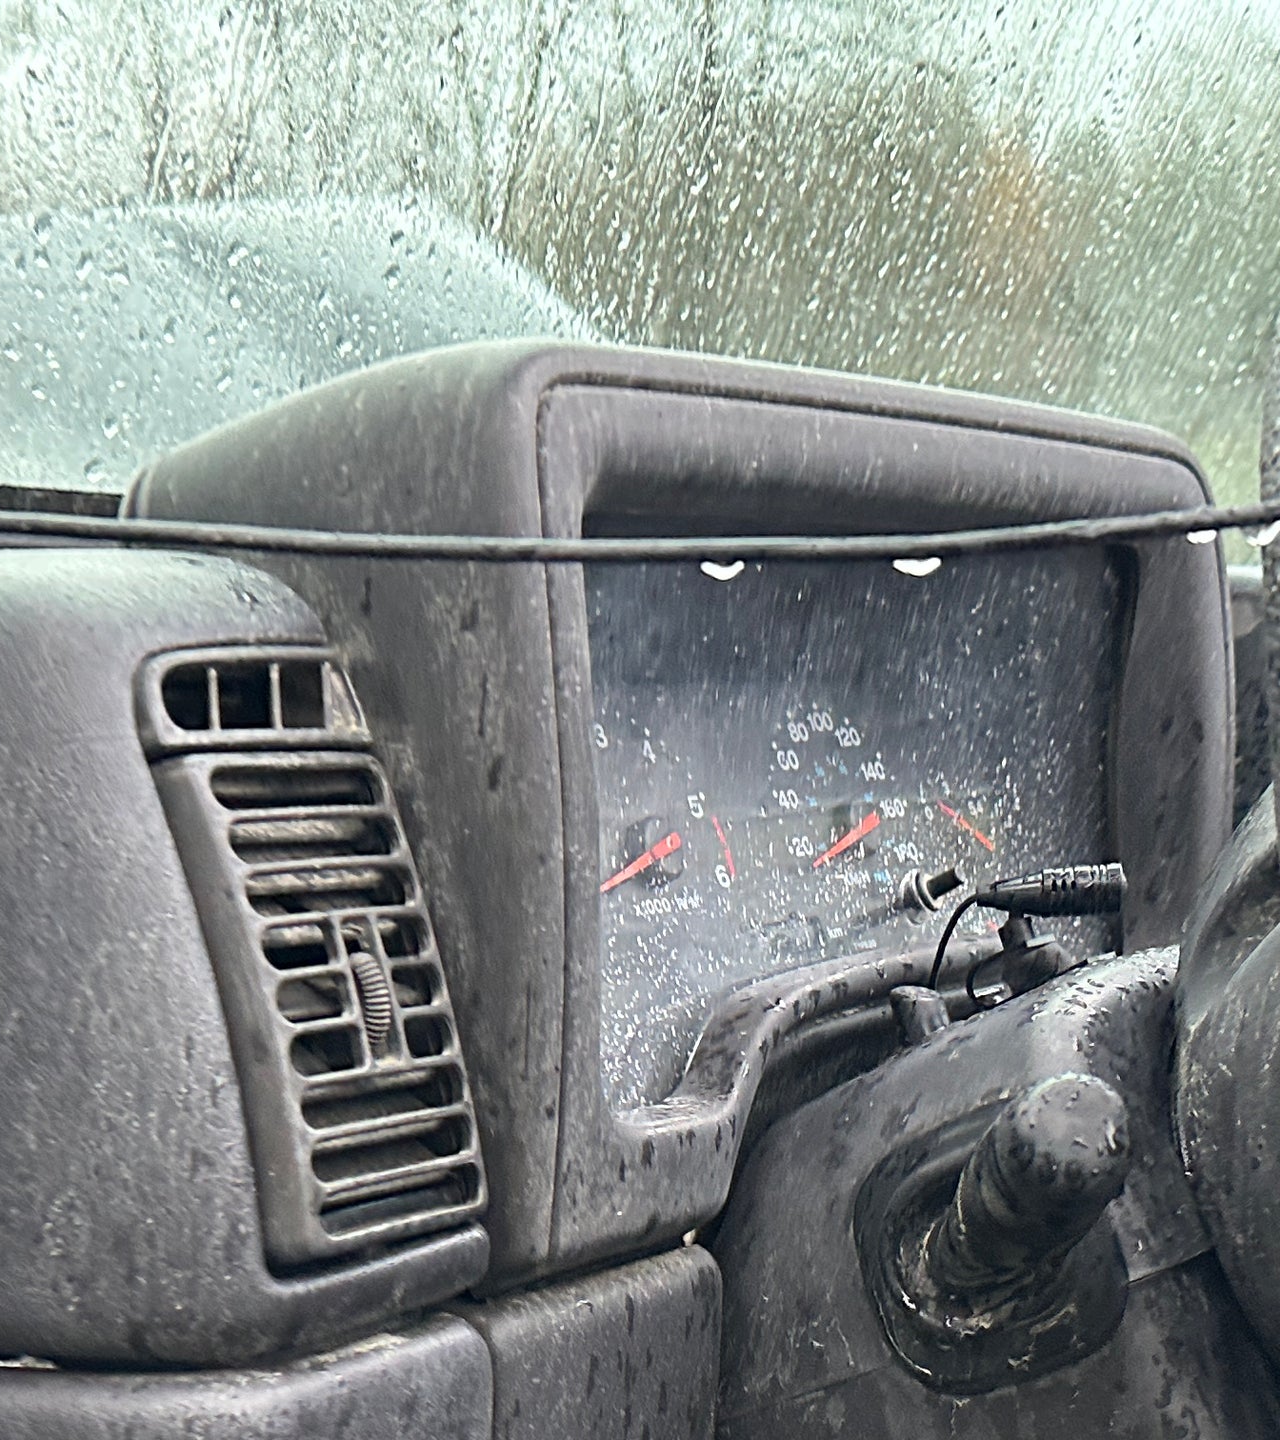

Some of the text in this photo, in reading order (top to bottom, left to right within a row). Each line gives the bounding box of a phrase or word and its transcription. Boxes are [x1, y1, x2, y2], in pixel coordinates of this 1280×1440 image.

[787, 720, 809, 743] 80
[806, 711, 834, 733] 100
[595, 723, 608, 749] 3
[835, 726, 861, 747] 120
[860, 760, 886, 782] 140
[687, 795, 704, 819] 5
[778, 788, 799, 810] 40
[879, 798, 906, 819] 160
[791, 835, 814, 857] 20
[714, 864, 731, 889] 6
